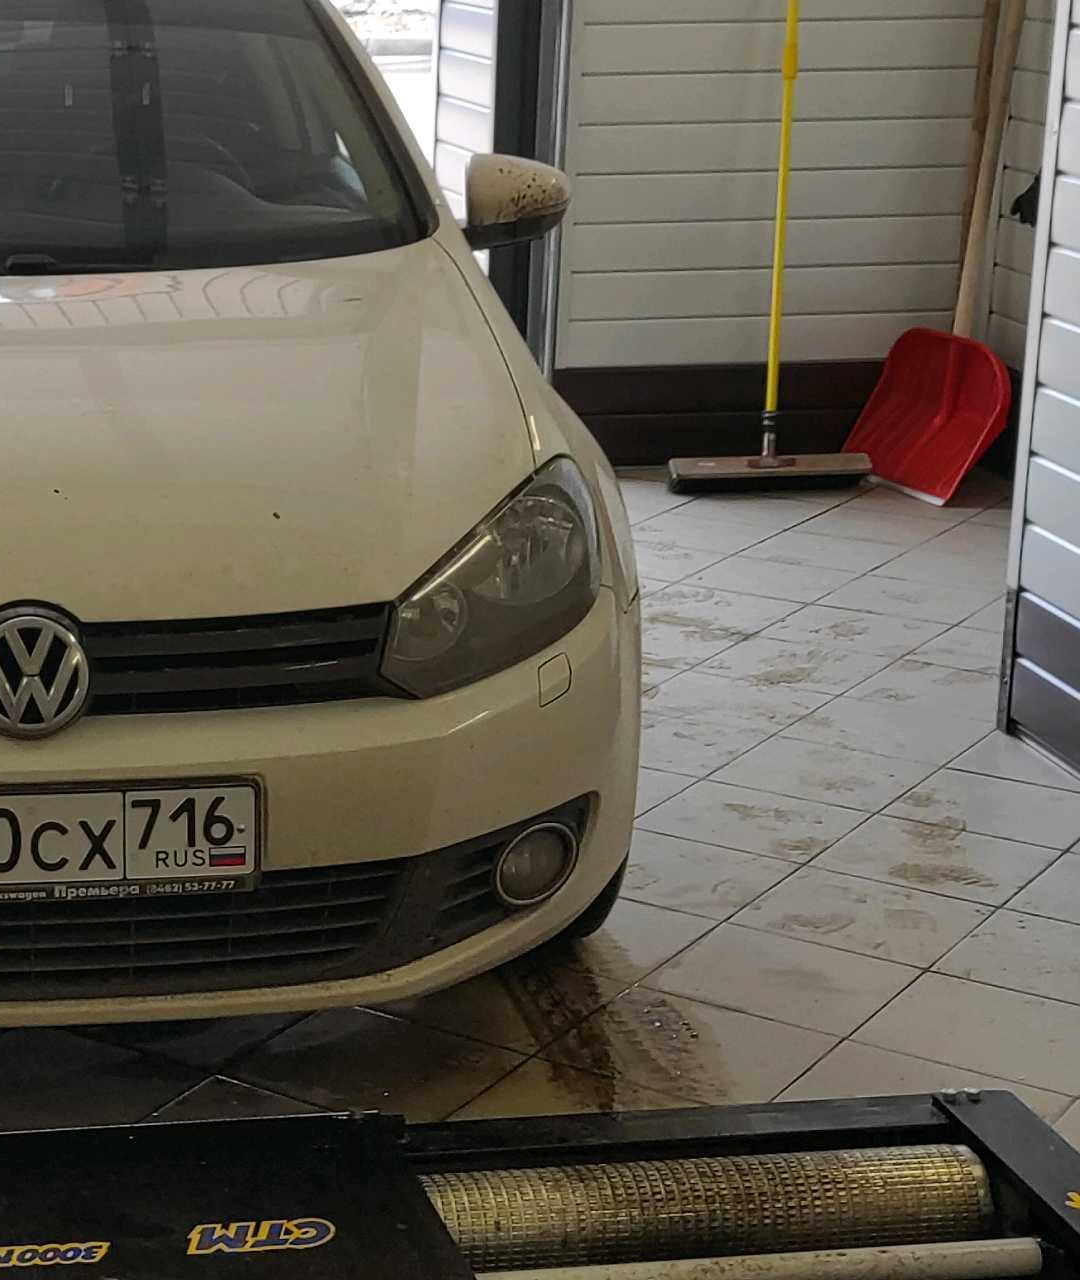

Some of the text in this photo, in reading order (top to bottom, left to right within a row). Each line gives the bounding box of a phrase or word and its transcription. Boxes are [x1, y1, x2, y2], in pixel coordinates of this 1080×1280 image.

[130, 795, 235, 850] 716
[155, 848, 207, 869] RUS
[53, 884, 140, 900] Премьера
